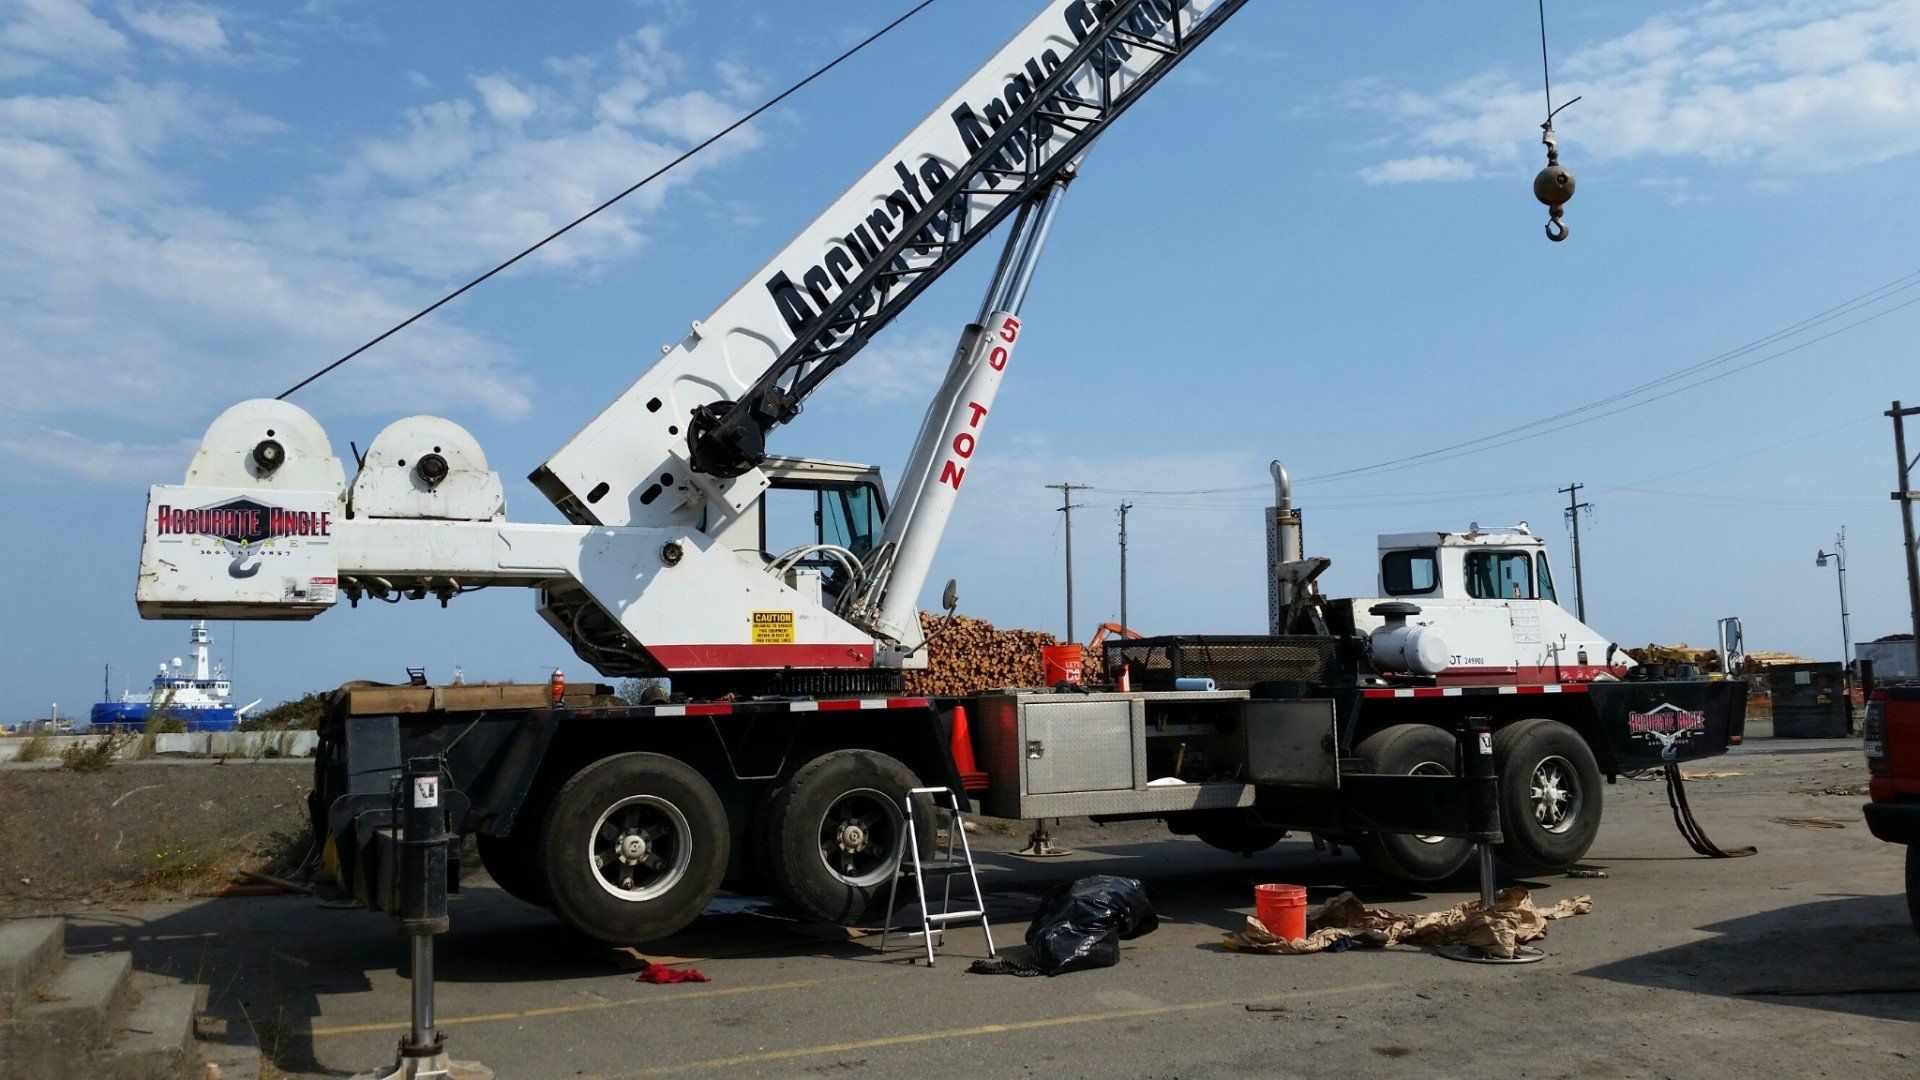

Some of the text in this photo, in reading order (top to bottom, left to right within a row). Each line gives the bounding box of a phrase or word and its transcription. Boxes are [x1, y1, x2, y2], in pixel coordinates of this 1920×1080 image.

[939, 317, 1020, 491] 50 TON
[157, 504, 332, 537] ACCURATE ANGLE
[191, 538, 299, 548] CRANE
[755, 613, 791, 622] CAUTION
